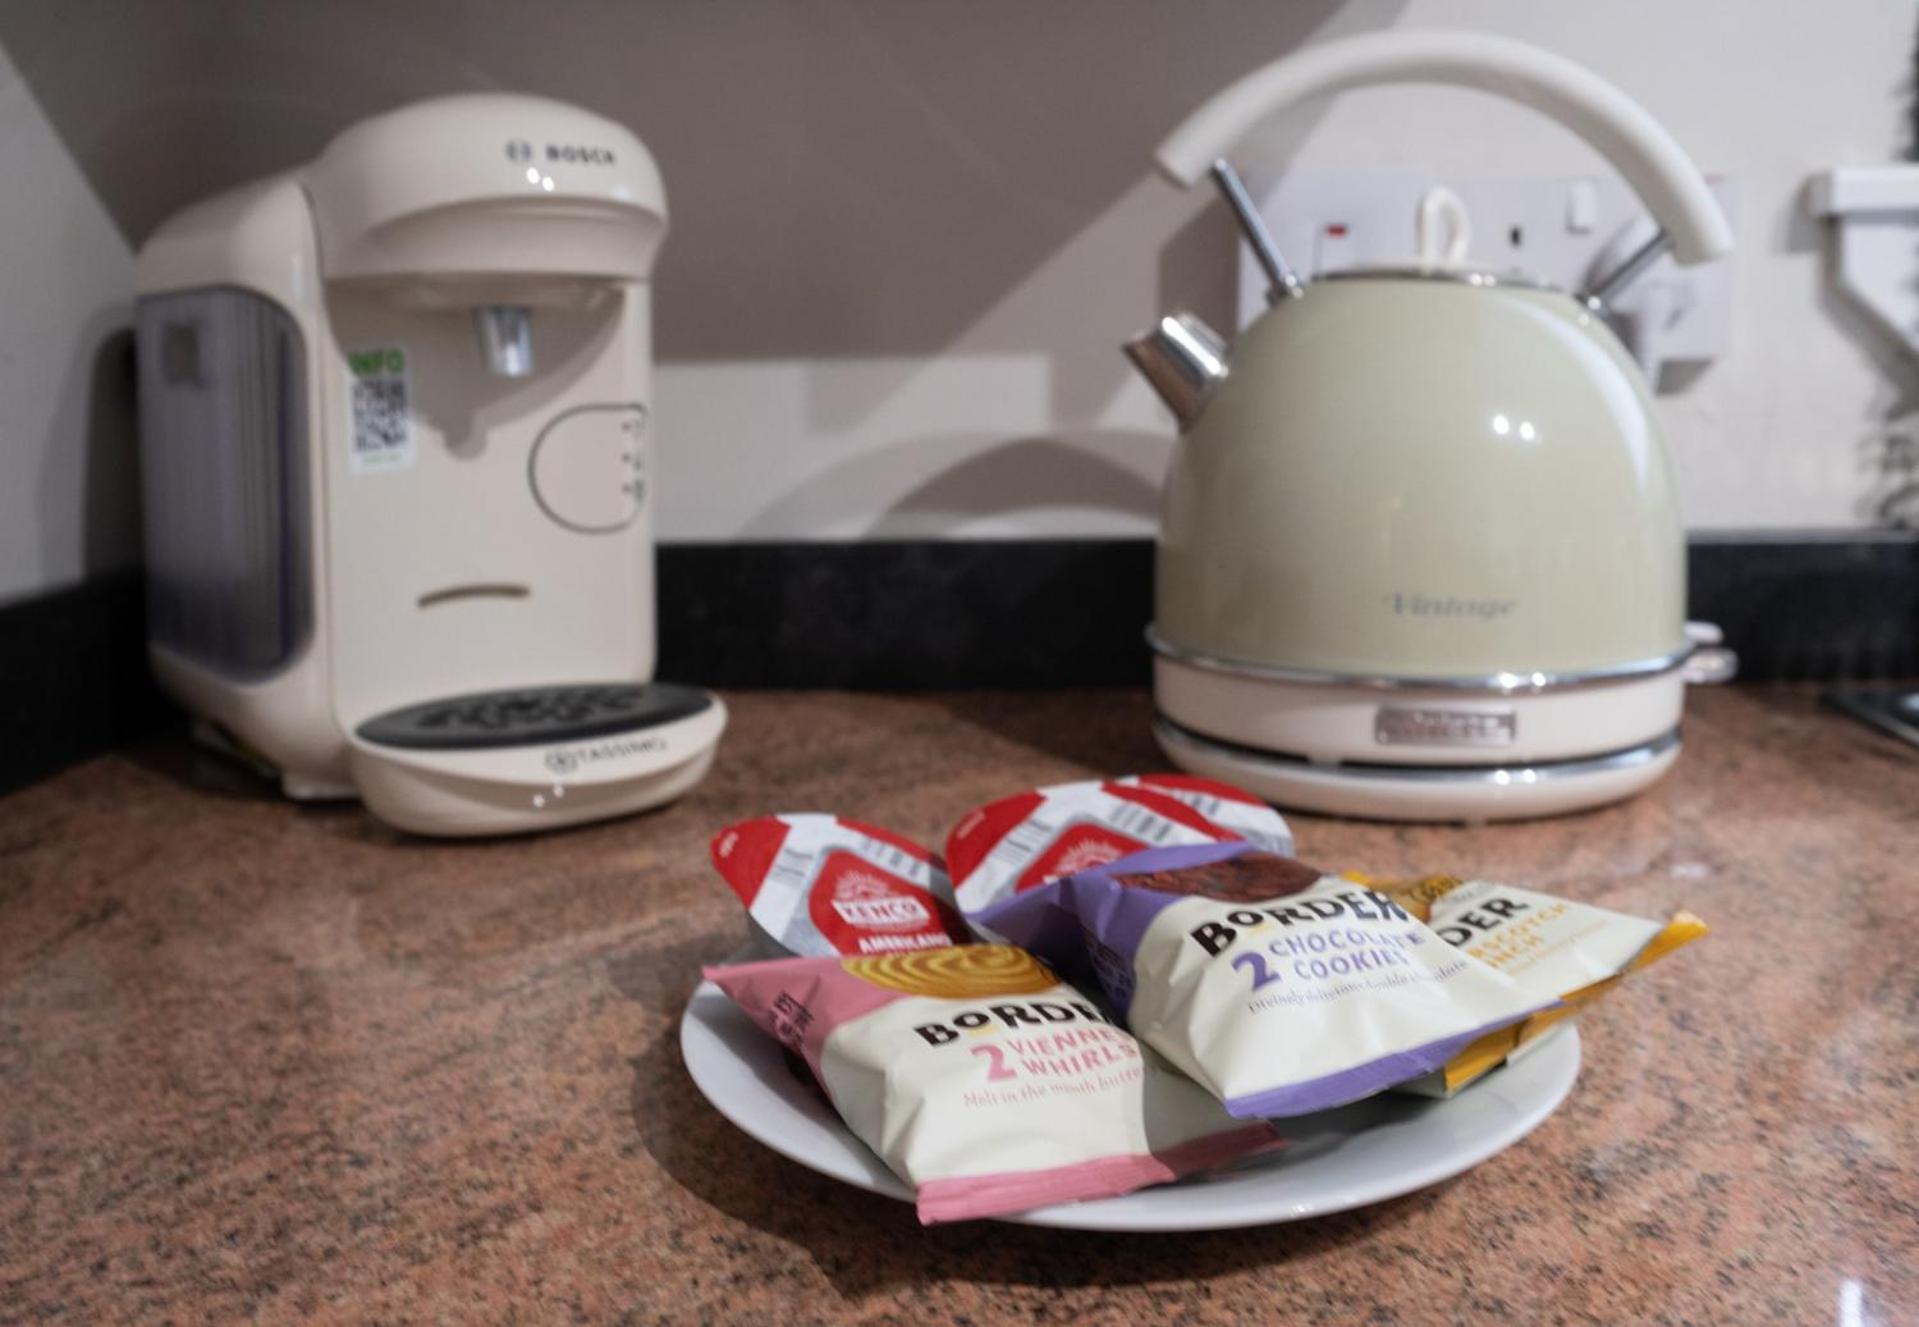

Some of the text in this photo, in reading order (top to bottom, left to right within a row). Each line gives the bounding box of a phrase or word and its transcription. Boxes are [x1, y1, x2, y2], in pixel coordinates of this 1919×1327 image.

[545, 143, 616, 165] BOSCH
[1385, 591, 1516, 622] Vintage
[577, 737, 668, 764] TASSIMO
[841, 901, 918, 919] KENCO
[1190, 890, 1409, 957] BORDER
[1436, 898, 1530, 947] DER
[1231, 951, 1282, 992] 2
[1268, 928, 1425, 957] CHOCOLATE
[1294, 949, 1409, 980] COOKIES
[913, 1002, 1112, 1047] BORDE
[970, 1027, 1117, 1082] 2 VIENNE
[1021, 1045, 1138, 1077] WHIRLS
